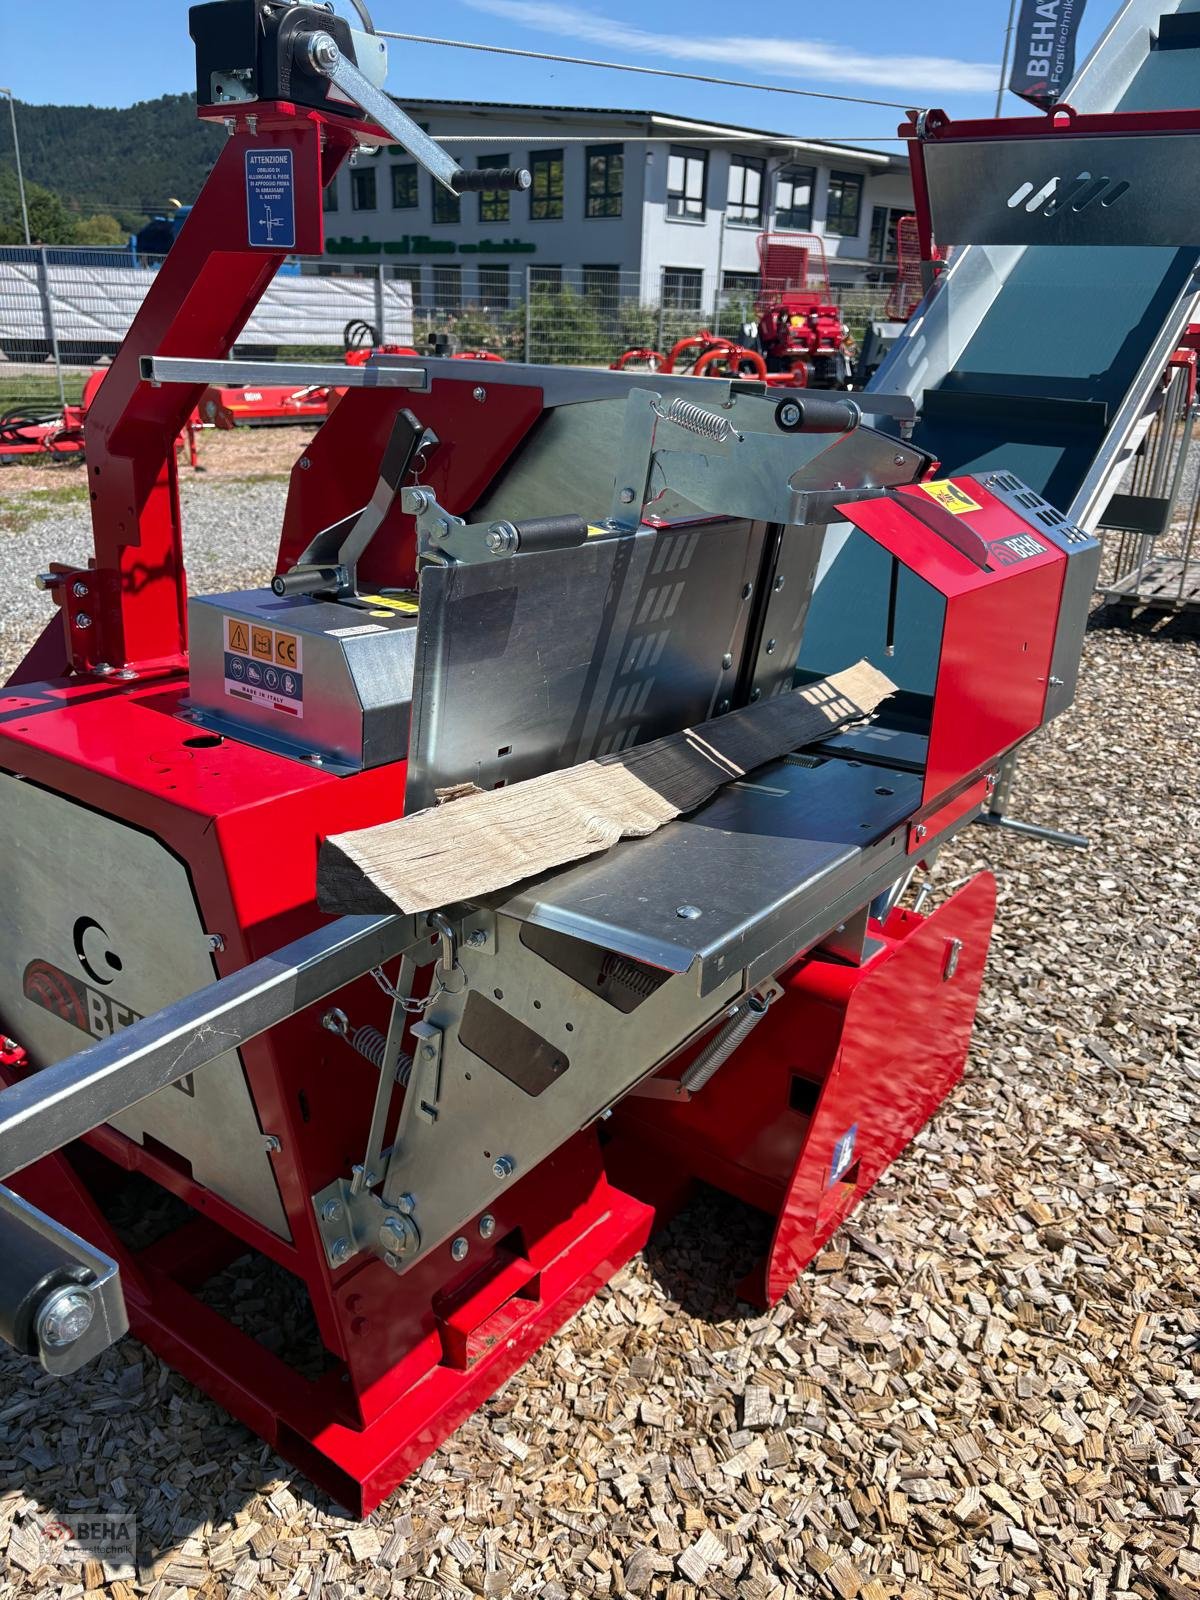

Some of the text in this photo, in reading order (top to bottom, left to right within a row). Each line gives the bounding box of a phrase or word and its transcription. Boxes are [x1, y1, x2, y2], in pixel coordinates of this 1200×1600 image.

[1026, 0, 1061, 77] BEHA
[249, 155, 288, 164] ATTENZIONE
[1006, 534, 1047, 559] BEHA
[241, 686, 258, 695] MADE
[267, 694, 284, 704] ITALY
